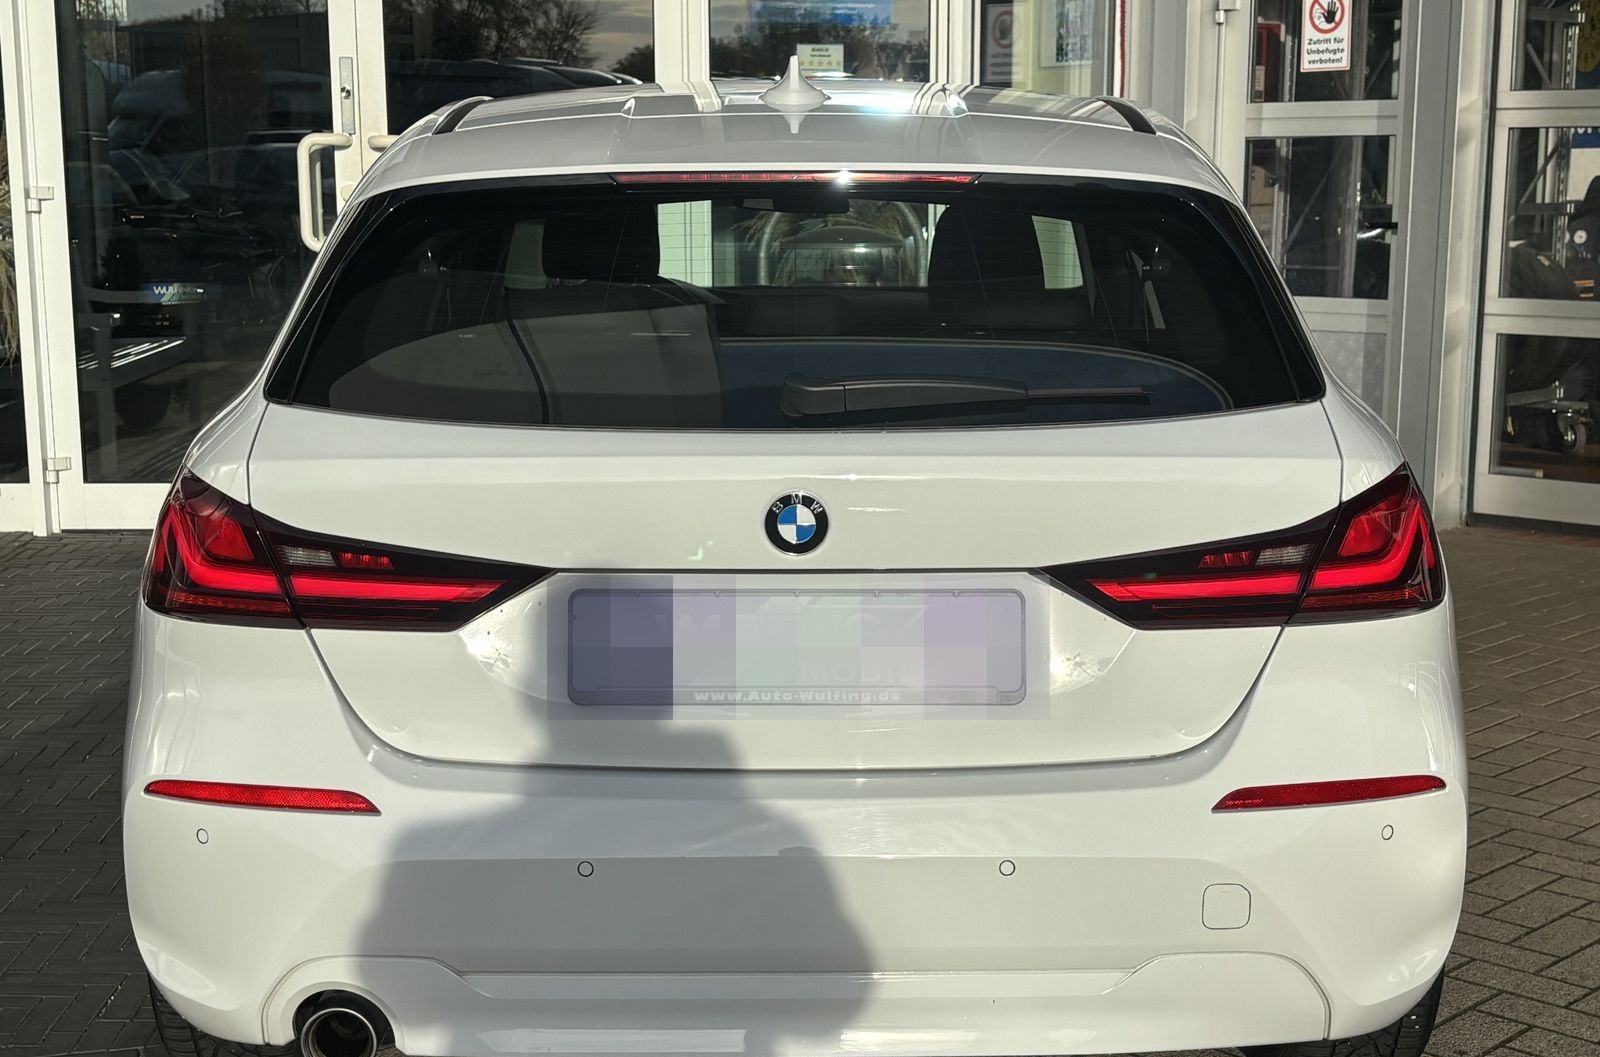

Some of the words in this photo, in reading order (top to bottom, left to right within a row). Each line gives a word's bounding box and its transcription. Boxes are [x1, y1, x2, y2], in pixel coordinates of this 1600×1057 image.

[1306, 47, 1345, 55] Unbefugte
[1308, 56, 1343, 64] verboten!
[771, 493, 824, 514] BMW
